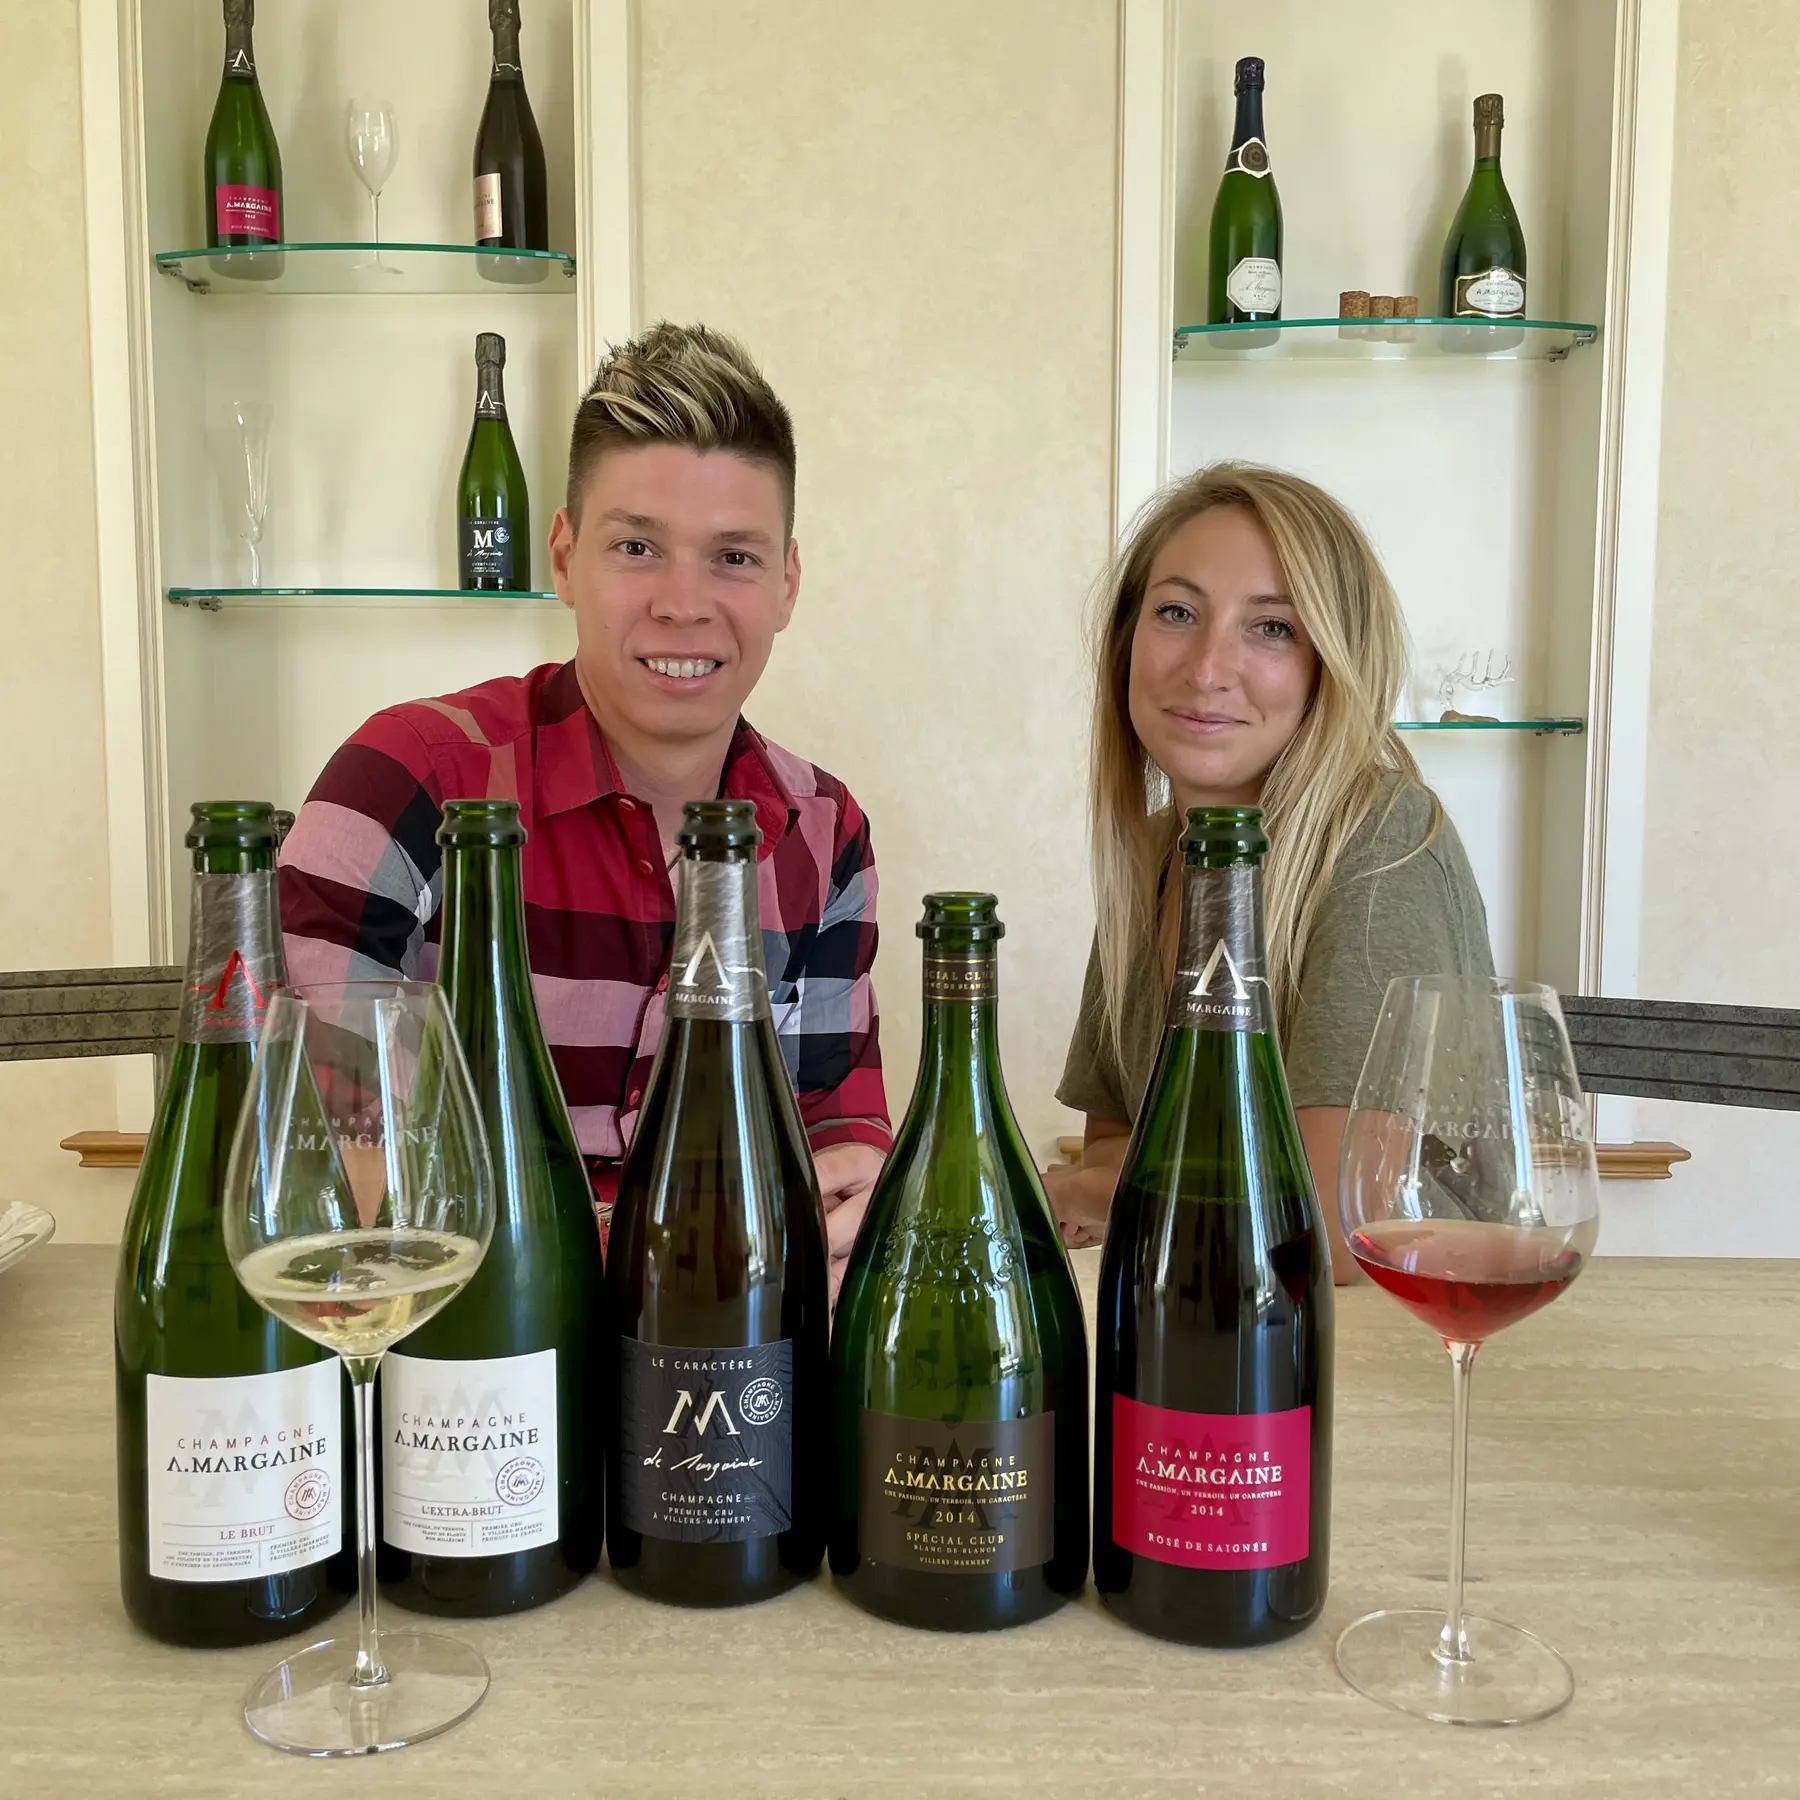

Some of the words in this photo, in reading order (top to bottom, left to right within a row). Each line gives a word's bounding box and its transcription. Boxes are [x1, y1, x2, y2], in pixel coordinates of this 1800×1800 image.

[473, 529, 494, 549] M
[1186, 1002, 1251, 1016] MARGAINE
[652, 1358, 664, 1368] LE
[674, 1359, 752, 1371] CARACTÈRE
[402, 1412, 527, 1428] CHAMPAGNE
[178, 1424, 314, 1449] CHAMPAGNE
[394, 1428, 539, 1453] A.MARGAINE
[167, 1437, 326, 1473] A.MARGAINE
[1147, 1442, 1270, 1463] CHAMPAGNE
[896, 1452, 1016, 1468] CHAMPAGNE
[1136, 1456, 1283, 1485] A.MARGAINE
[883, 1467, 1028, 1491] A.MARGAINE
[1136, 1478, 1148, 1488] UNE
[1242, 1489, 1283, 1500] CARACTÈRE
[662, 1492, 742, 1504] CHAMPAGNE
[885, 1489, 896, 1498] UNE
[976, 1496, 987, 1504] UN
[988, 1493, 1028, 1504] CARACTÈRE
[422, 1505, 503, 1517] L'EXTRA-BRUT
[669, 1507, 708, 1517] PREMIER
[715, 1508, 734, 1516] CRU
[935, 1510, 975, 1524] 2014
[1190, 1504, 1224, 1517] 2014
[664, 1514, 751, 1525] VILLERS-MARMERY
[220, 1531, 236, 1541] LE
[240, 1525, 276, 1539] BRUT
[520, 1528, 543, 1537] FRANCE
[906, 1531, 963, 1545] SPÉCIAL
[969, 1534, 1005, 1545] CLUB
[270, 1540, 297, 1550] PREMIER
[914, 1544, 942, 1553] BLANC
[947, 1546, 958, 1554] DE
[962, 1546, 996, 1555] BLANCS
[1148, 1532, 1180, 1548] ROSÉ
[1185, 1541, 1202, 1551] DE
[1207, 1541, 1268, 1553] SAIGNÉE
[270, 1550, 298, 1561] PRODUIT
